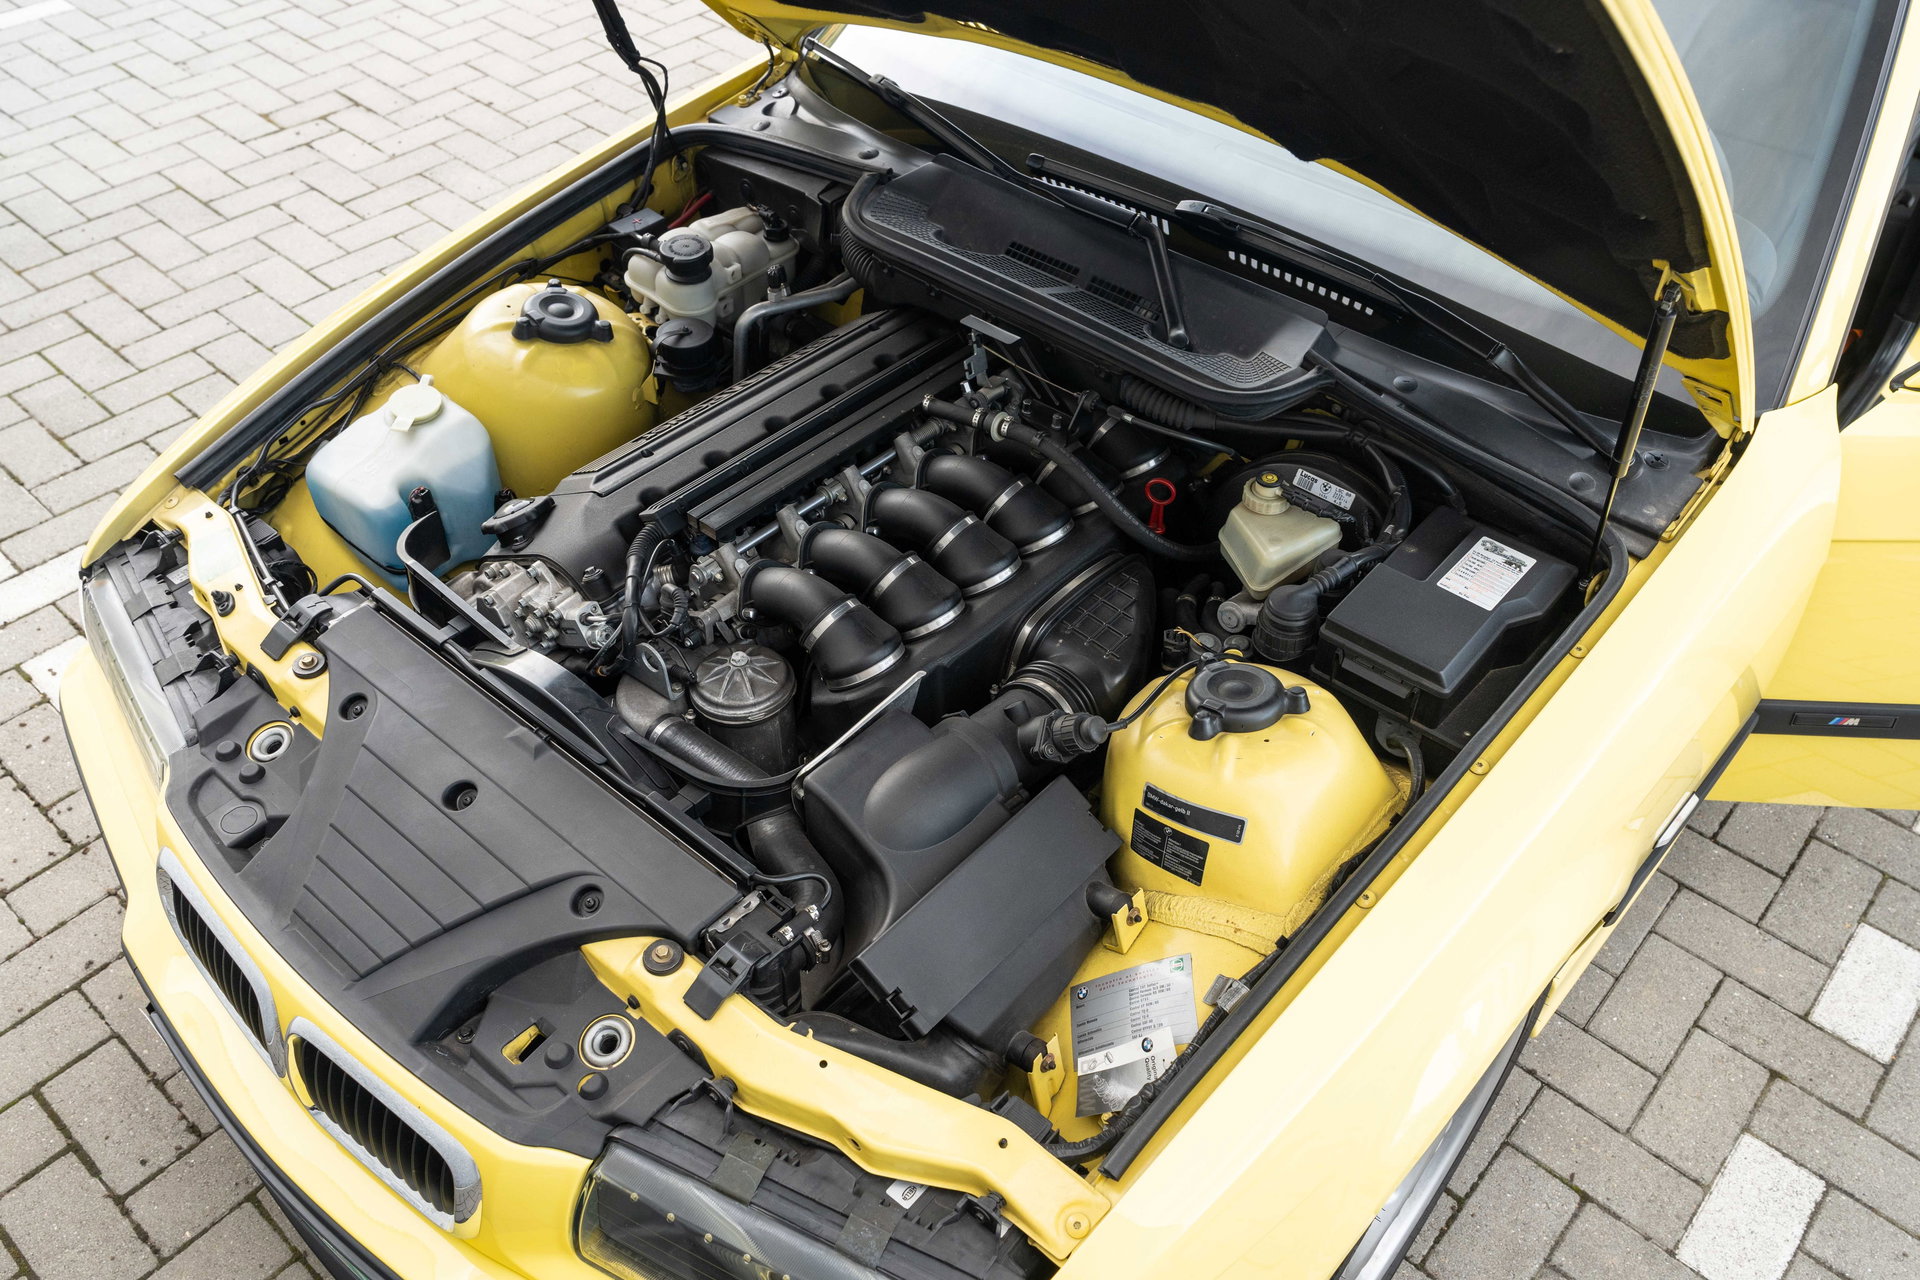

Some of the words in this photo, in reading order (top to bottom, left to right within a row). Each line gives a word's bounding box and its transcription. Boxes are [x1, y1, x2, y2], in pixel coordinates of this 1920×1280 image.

[1300, 470, 1318, 484] Lucas
[1150, 1055, 1158, 1080] Origina
[902, 1185, 917, 1201] HELLA
